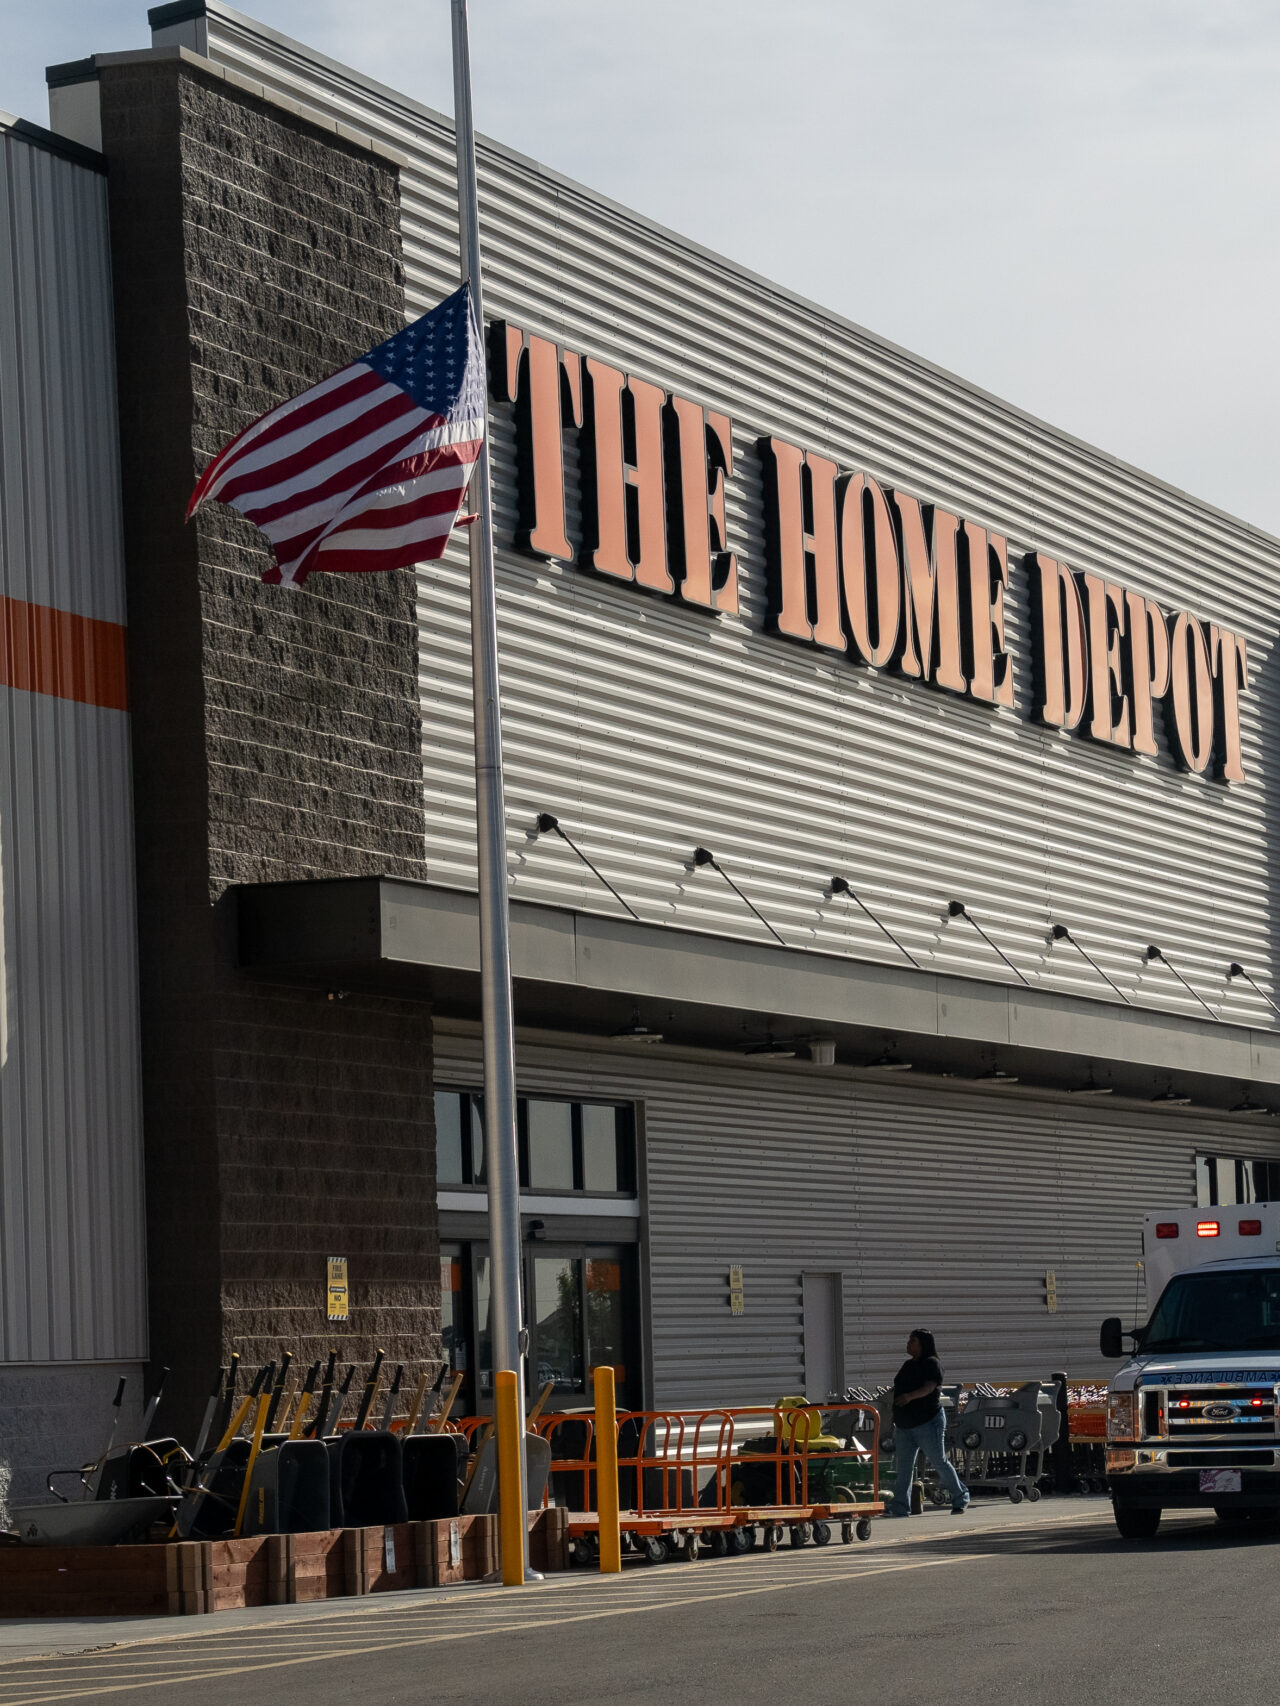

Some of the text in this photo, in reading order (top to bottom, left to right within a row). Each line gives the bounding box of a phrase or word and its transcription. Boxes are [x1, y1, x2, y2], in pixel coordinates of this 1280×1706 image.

[501, 320, 1248, 785] THE HOME DEPOT
[1211, 1408, 1228, 1416] Ford
[984, 1415, 1005, 1429] HD
